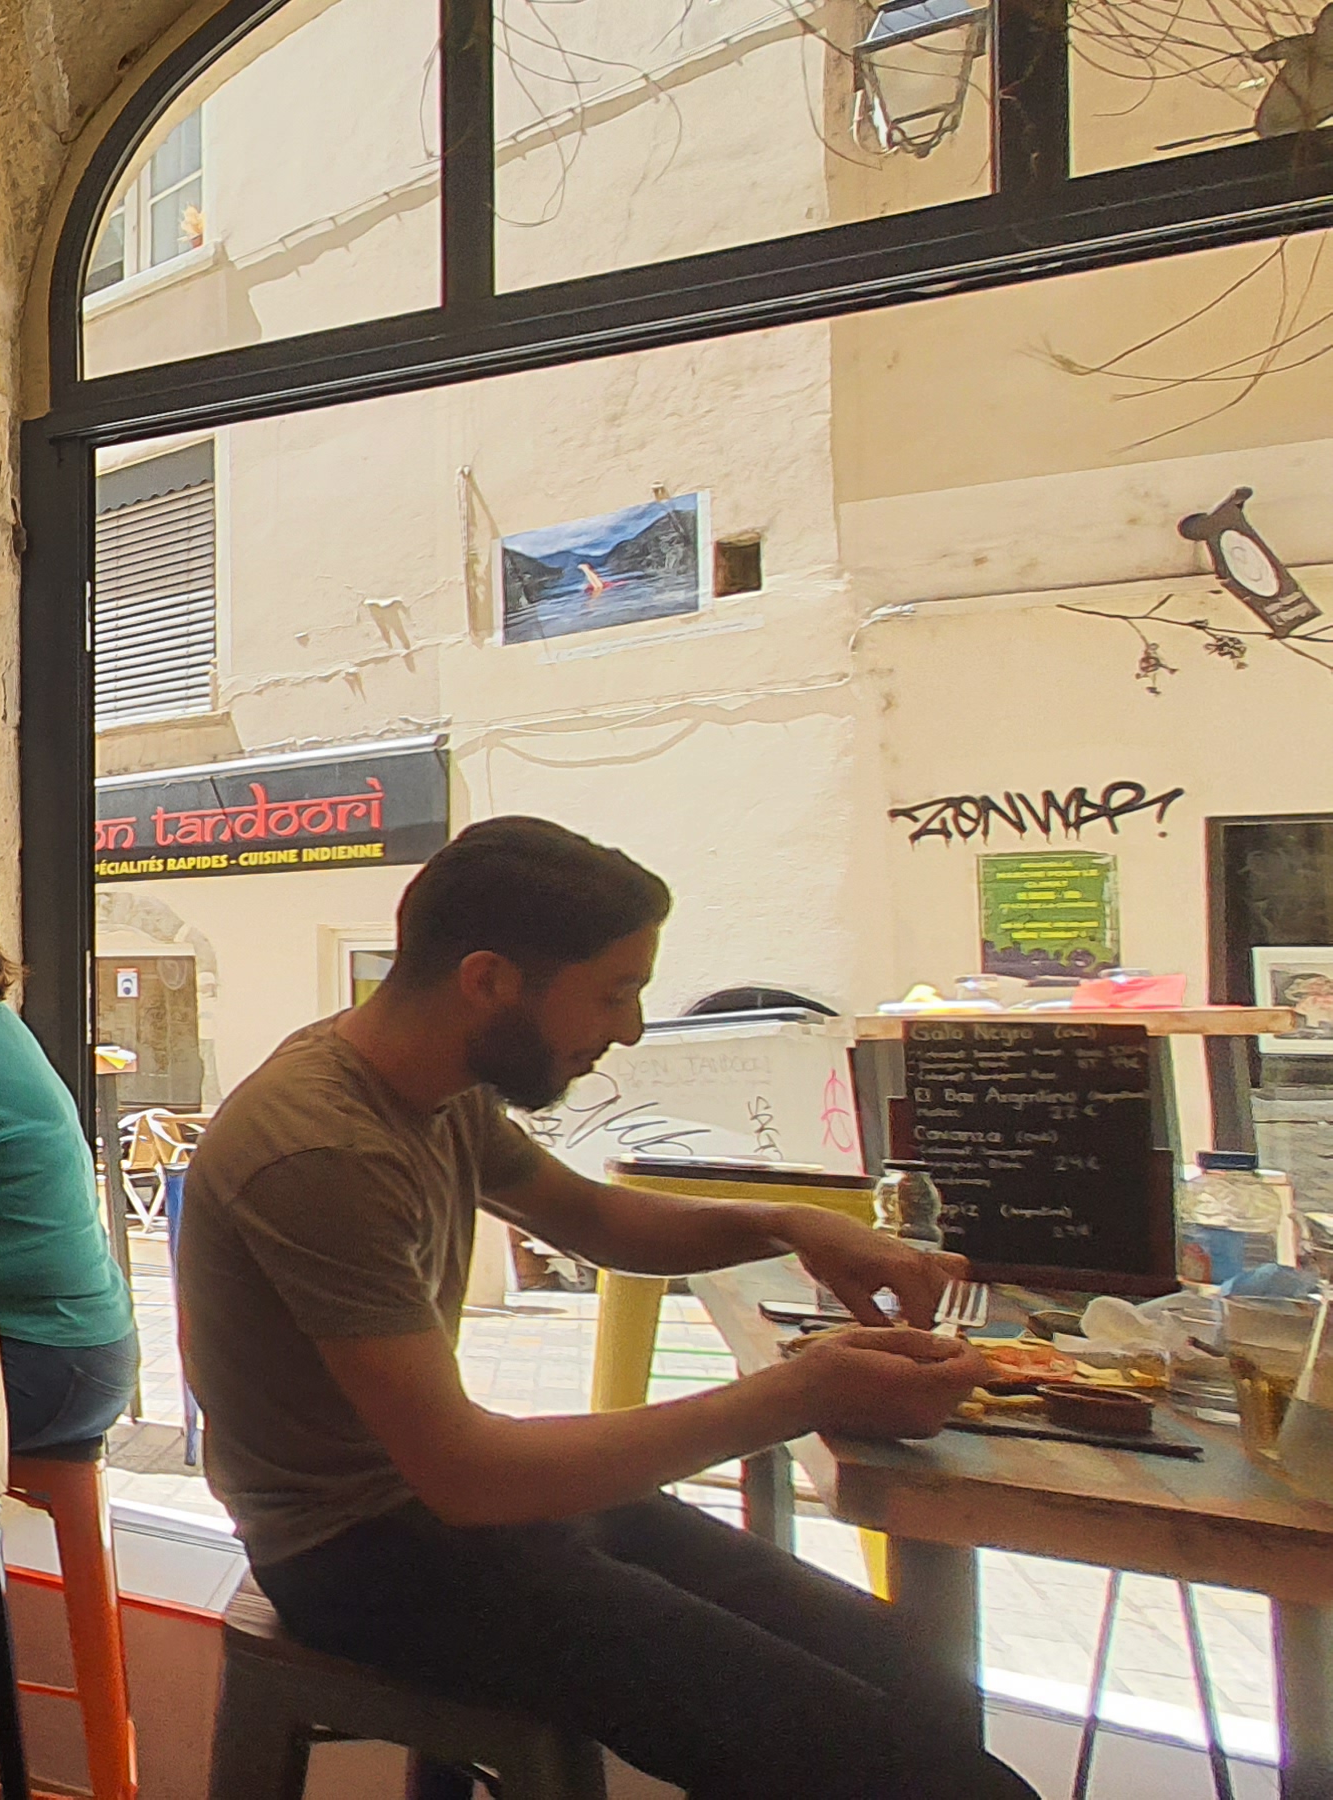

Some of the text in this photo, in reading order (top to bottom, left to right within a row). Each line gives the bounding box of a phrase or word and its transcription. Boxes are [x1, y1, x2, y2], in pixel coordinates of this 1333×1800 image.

[167, 855, 228, 873] RAPIDES
[239, 849, 299, 867] CUISINE
[302, 843, 384, 862] INDIENNE
